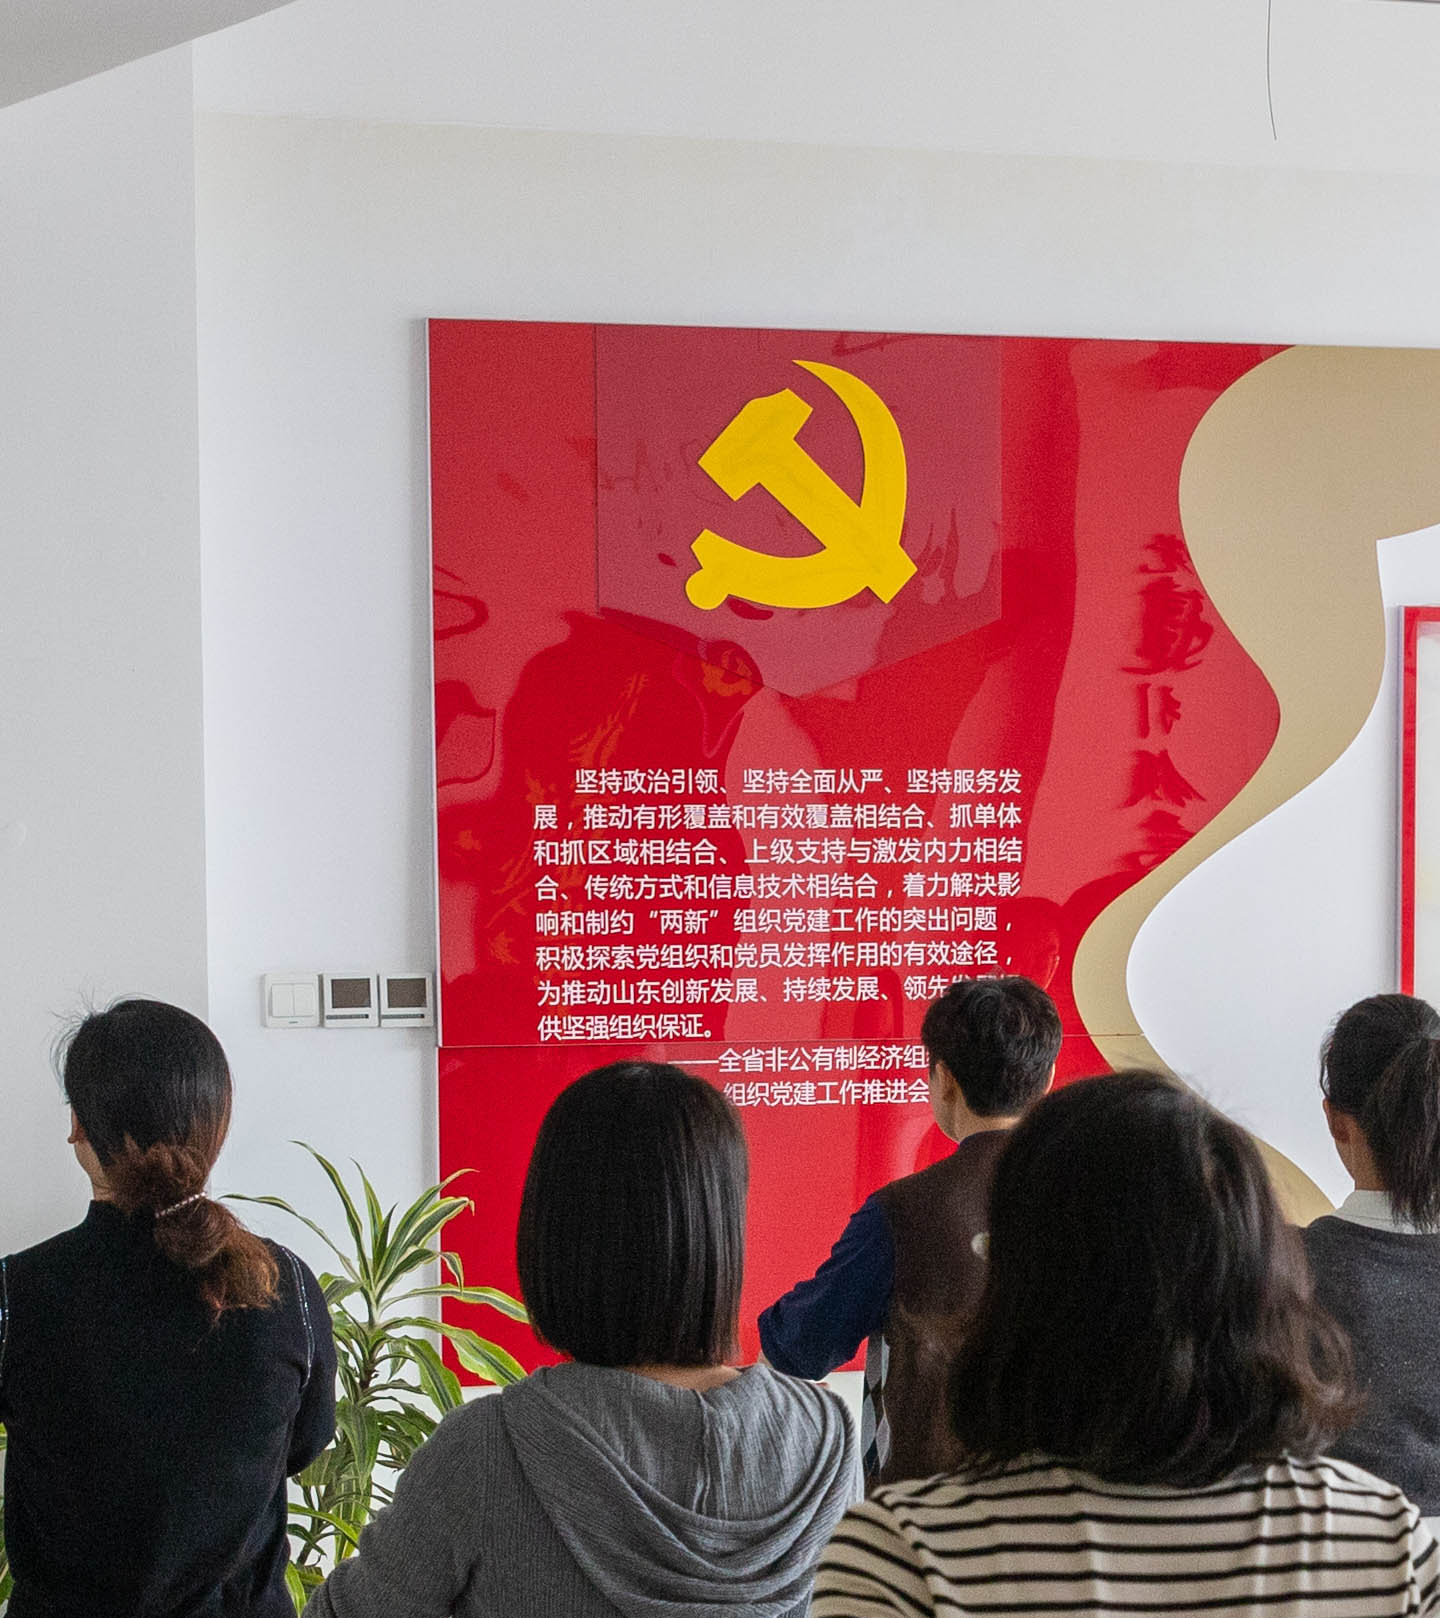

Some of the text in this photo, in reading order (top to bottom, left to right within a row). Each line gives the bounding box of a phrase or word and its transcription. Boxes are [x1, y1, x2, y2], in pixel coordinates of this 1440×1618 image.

[575, 769, 1021, 795] 坚持政治引领、坚持全面从严、坚持服务发
[533, 804, 1021, 830] 展，推动有形覆盖和有效覆盖相结合、抓单体
[533, 838, 1021, 865] 和抓区域相结合、上级支持与激发内力相结
[535, 873, 1020, 900] 合、传统方式和信息技术相结合，着力解决影
[536, 941, 1012, 969] 积极探索党组织和党员发挥作用的有效途径，
[537, 975, 1016, 1004] 为推动山东创新发展、持续发展、领先
[538, 1013, 712, 1039] 供坚强组织保证。
